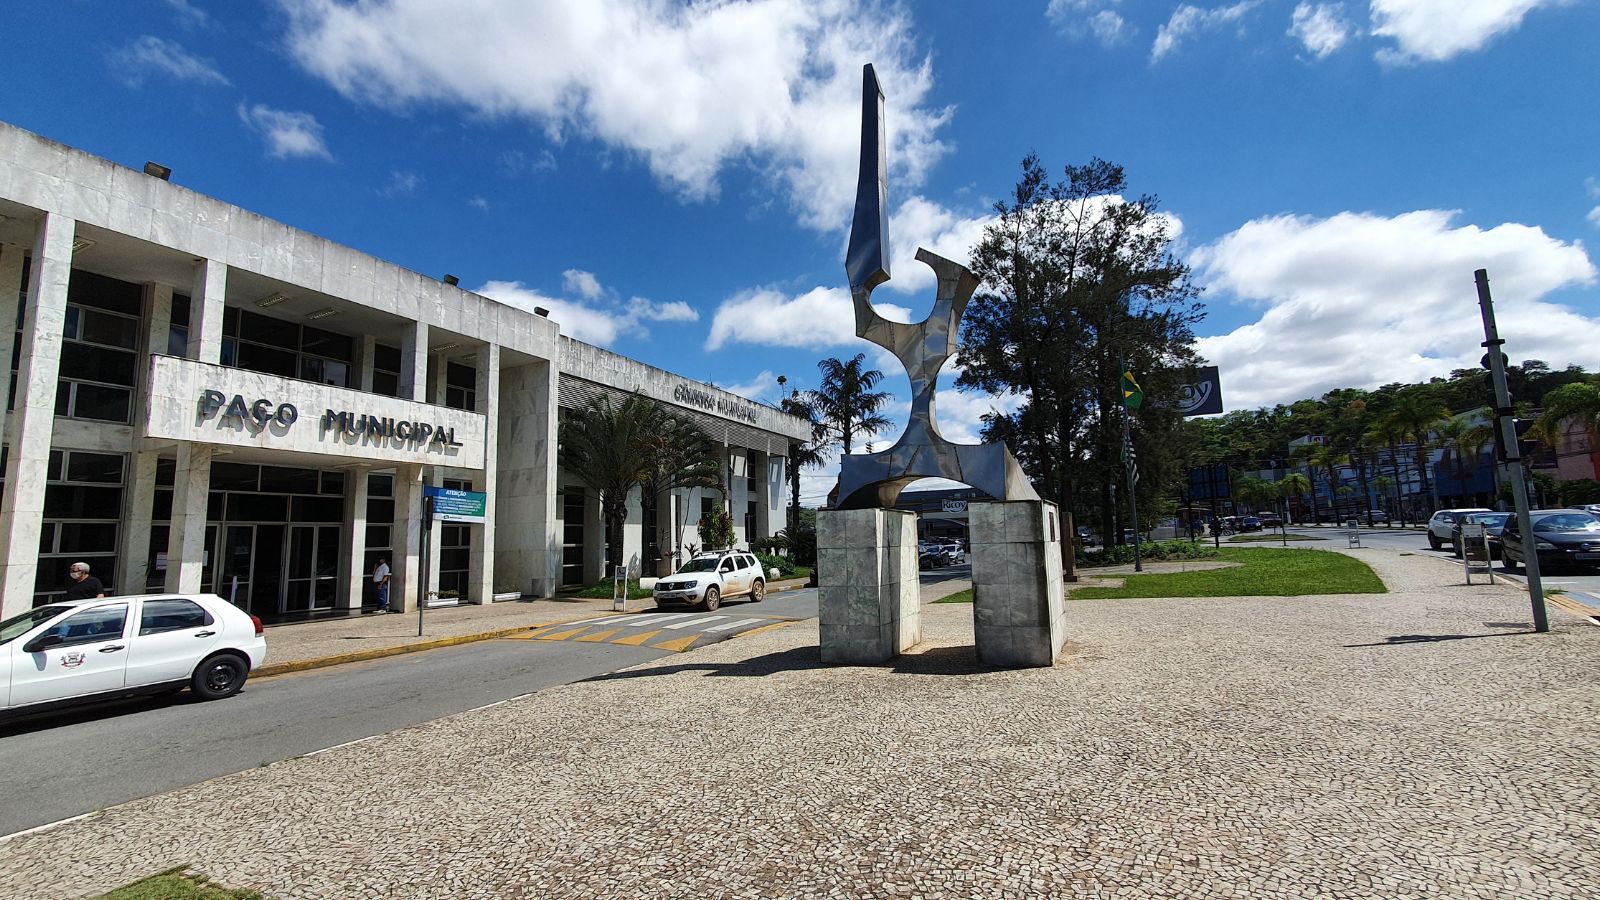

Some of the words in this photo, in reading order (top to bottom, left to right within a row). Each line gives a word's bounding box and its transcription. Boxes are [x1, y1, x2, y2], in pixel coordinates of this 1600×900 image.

[202, 388, 298, 426] PAÇO
[325, 408, 463, 447] MUNICIPAL
[717, 397, 757, 424] MUNICIPAL
[445, 489, 467, 498] ATENÇÃO
[943, 501, 967, 512] Ricoy
